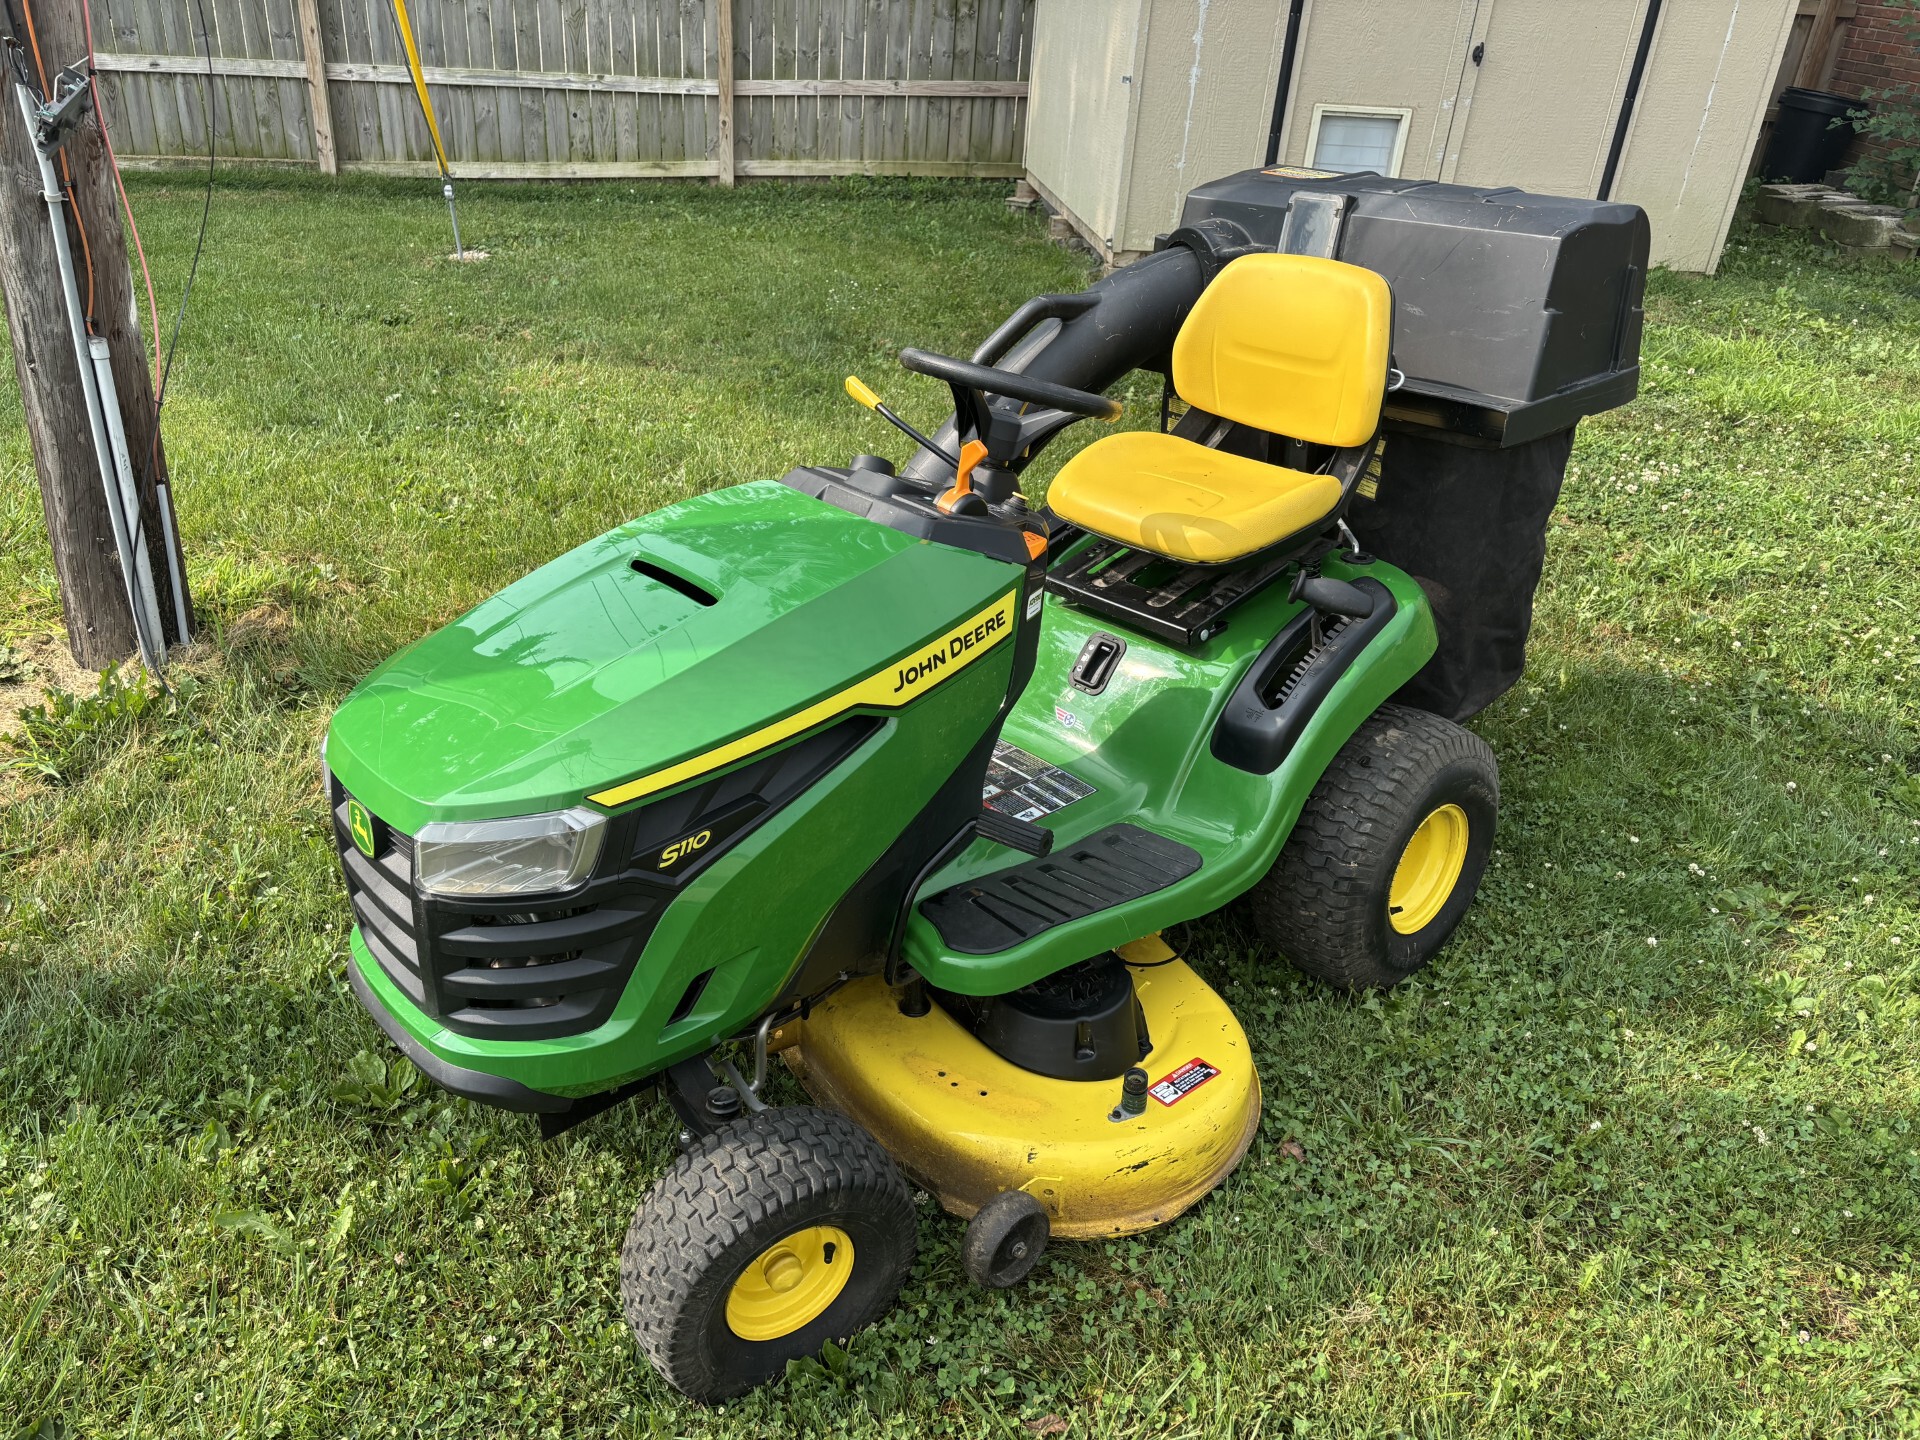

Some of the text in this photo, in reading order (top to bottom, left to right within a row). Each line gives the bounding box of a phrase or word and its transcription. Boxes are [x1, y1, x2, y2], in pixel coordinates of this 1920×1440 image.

[893, 609, 1006, 693] JOHN DEERE
[658, 830, 711, 869] S110
